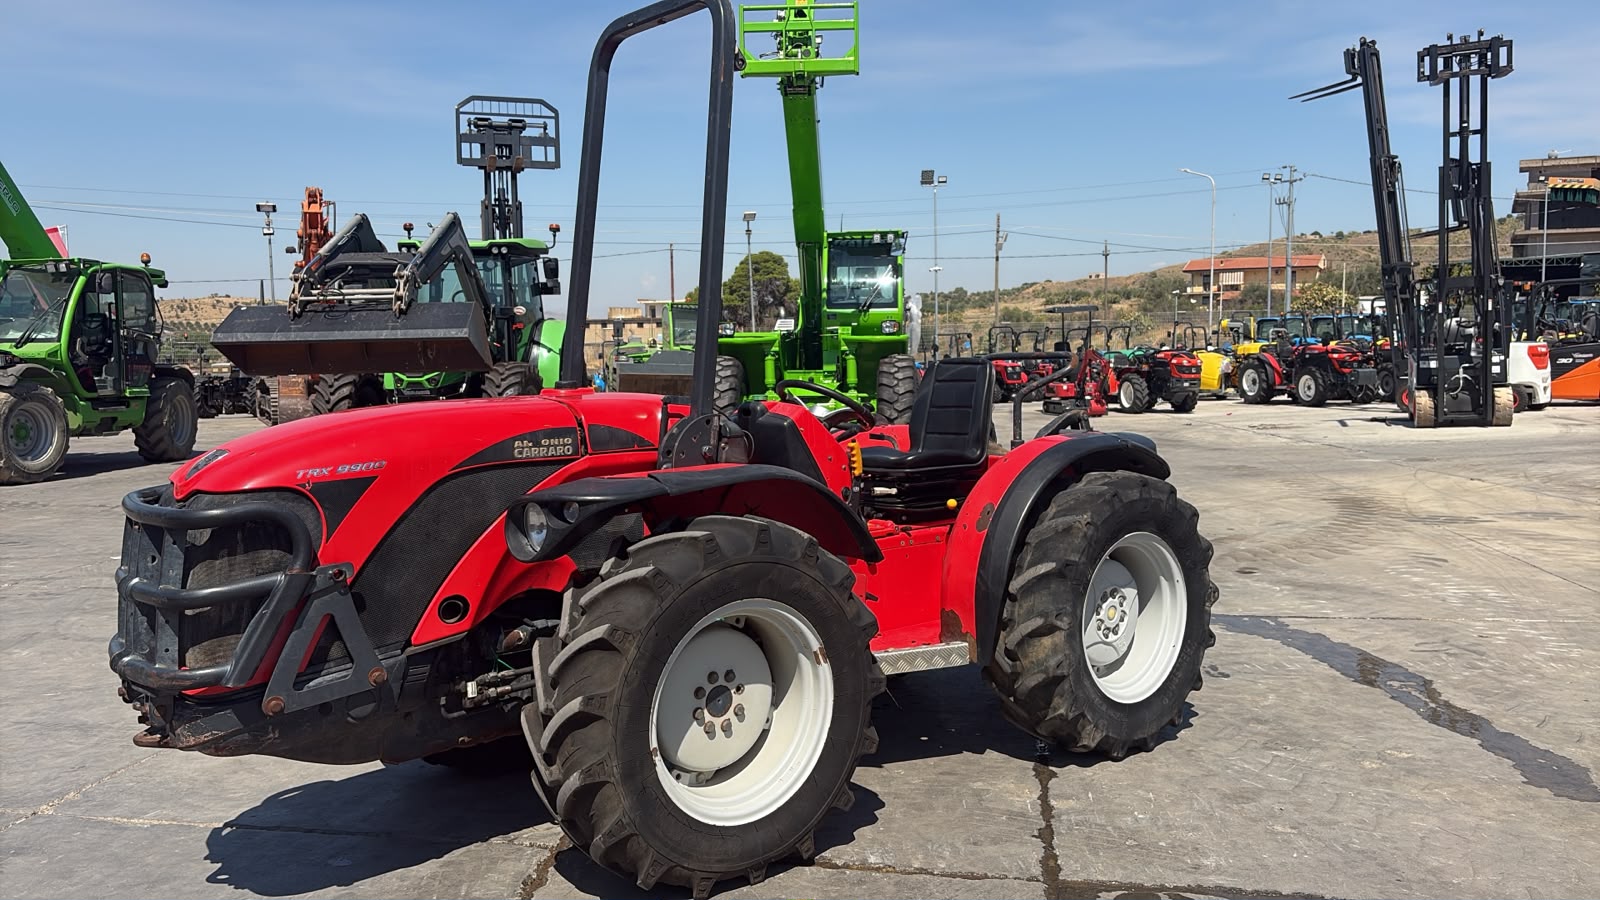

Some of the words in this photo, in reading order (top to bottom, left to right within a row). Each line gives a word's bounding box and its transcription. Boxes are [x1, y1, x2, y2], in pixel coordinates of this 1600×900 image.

[514, 437, 573, 448] ANONIO
[513, 445, 573, 458] CARRARO
[296, 466, 333, 480] TRX
[335, 460, 387, 474] 9900
